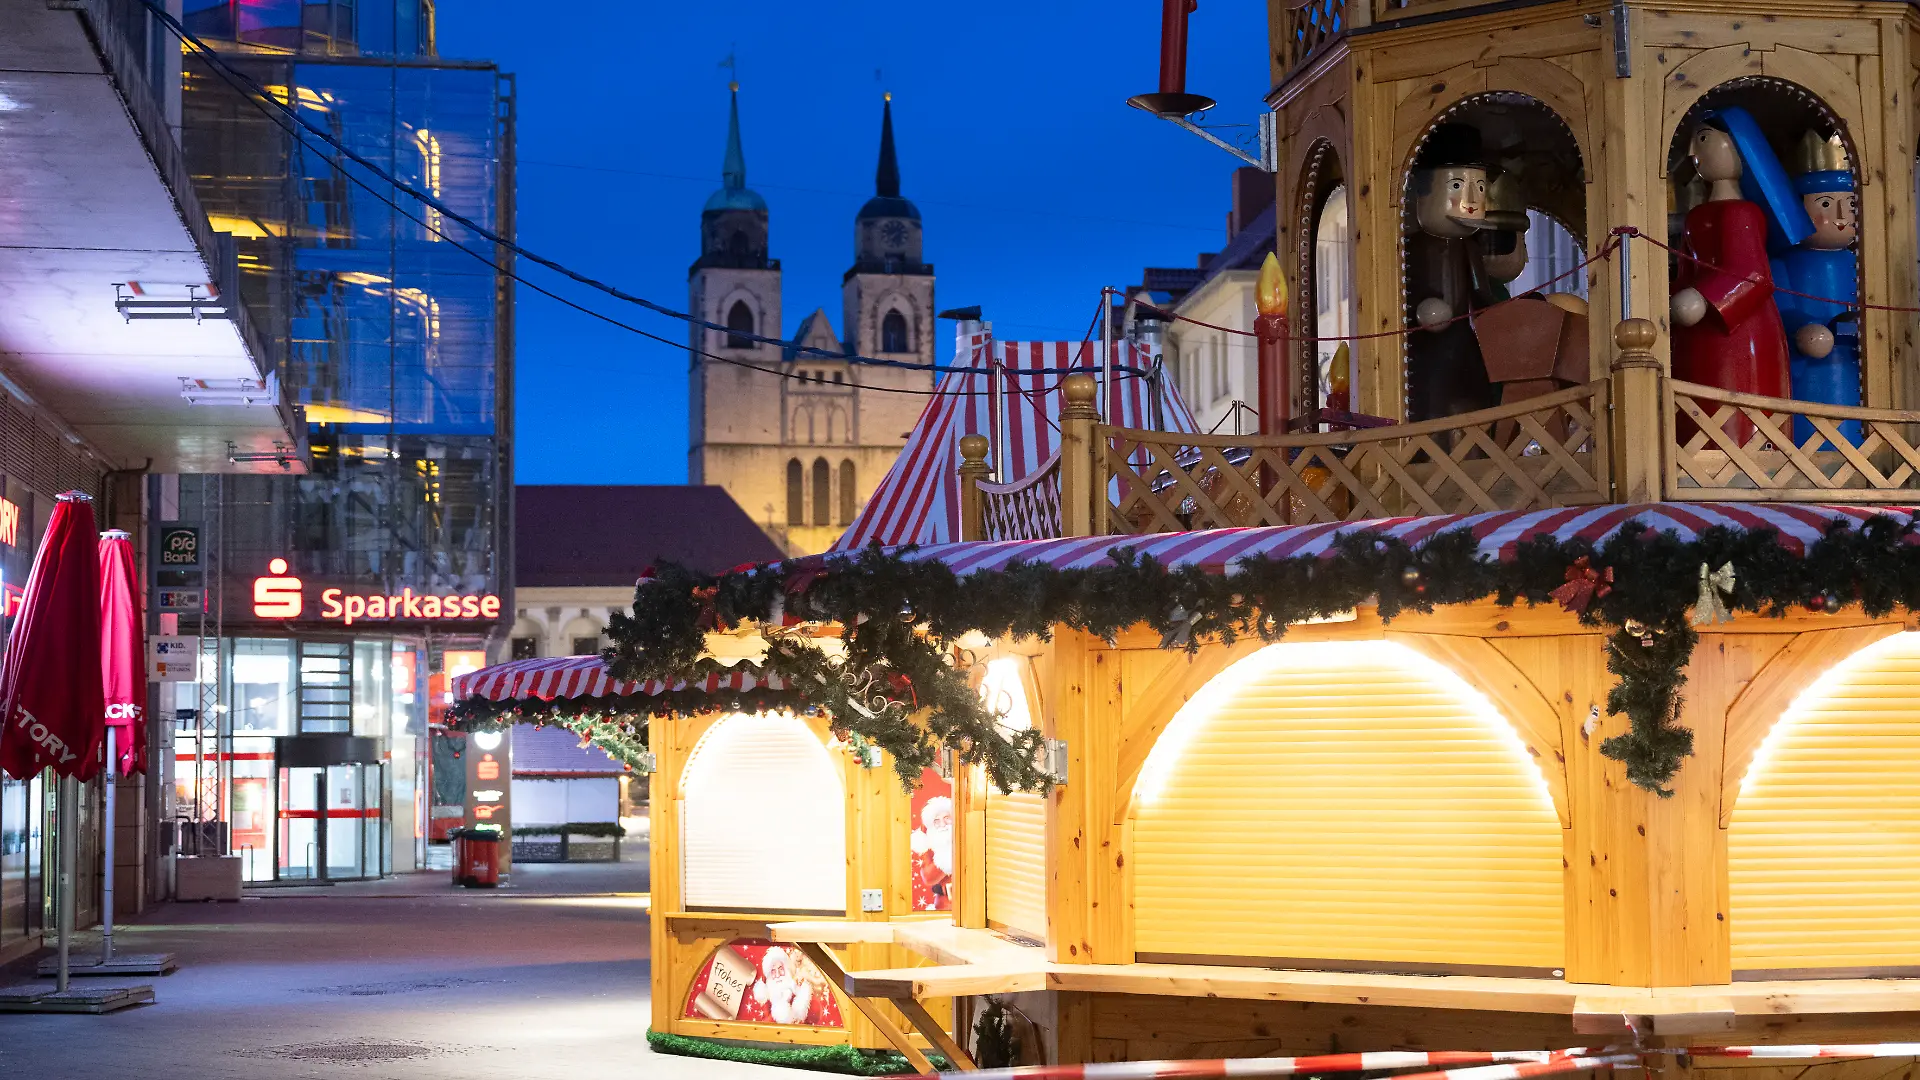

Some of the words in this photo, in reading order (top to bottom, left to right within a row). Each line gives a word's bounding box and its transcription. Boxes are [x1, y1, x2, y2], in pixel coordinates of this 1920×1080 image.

[0, 496, 19, 548] RY
[164, 551, 196, 563] Bank
[321, 587, 501, 625] Sparkasse
[714, 961, 743, 993] Frohes
[713, 982, 731, 1006] Fest
